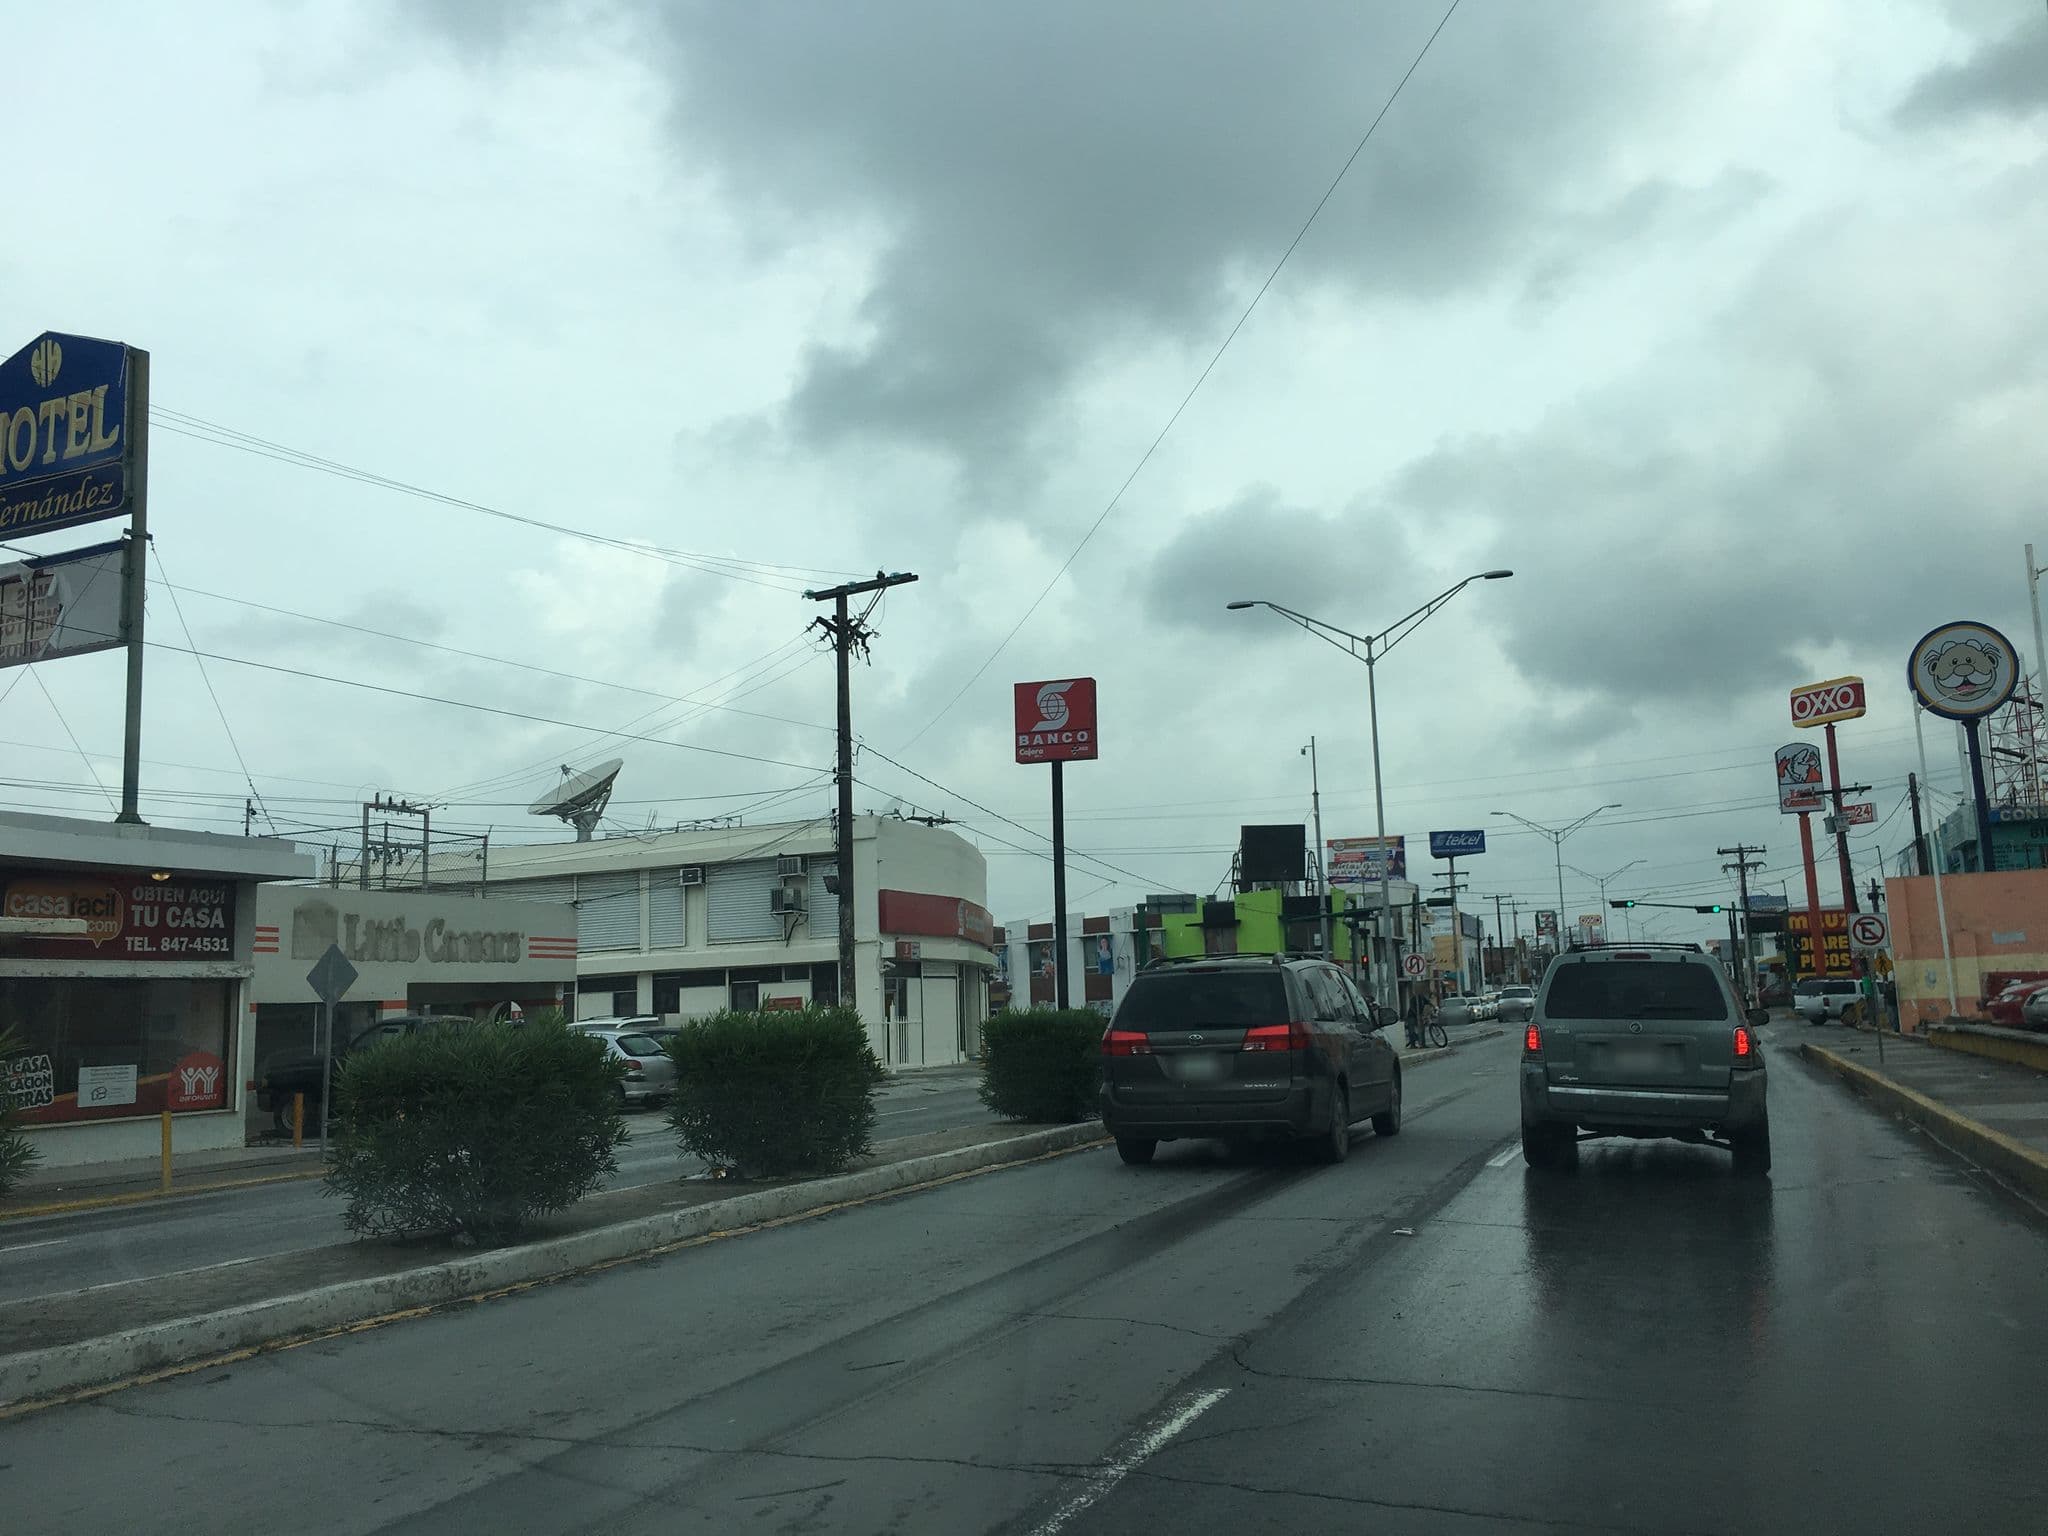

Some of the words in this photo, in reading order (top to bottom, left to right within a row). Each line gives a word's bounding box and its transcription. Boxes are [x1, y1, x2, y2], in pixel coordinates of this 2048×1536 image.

[0, 475, 113, 528] ernández
[1793, 686, 1855, 720] OXXO
[1019, 731, 1088, 746] BANCO
[1019, 747, 1044, 756] Cajero
[1855, 804, 1871, 817] 24
[132, 886, 185, 903] OBTEN
[131, 904, 160, 928] TU
[165, 906, 225, 929] CASA
[125, 936, 157, 952] TEL.
[160, 936, 230, 952] 847-4531
